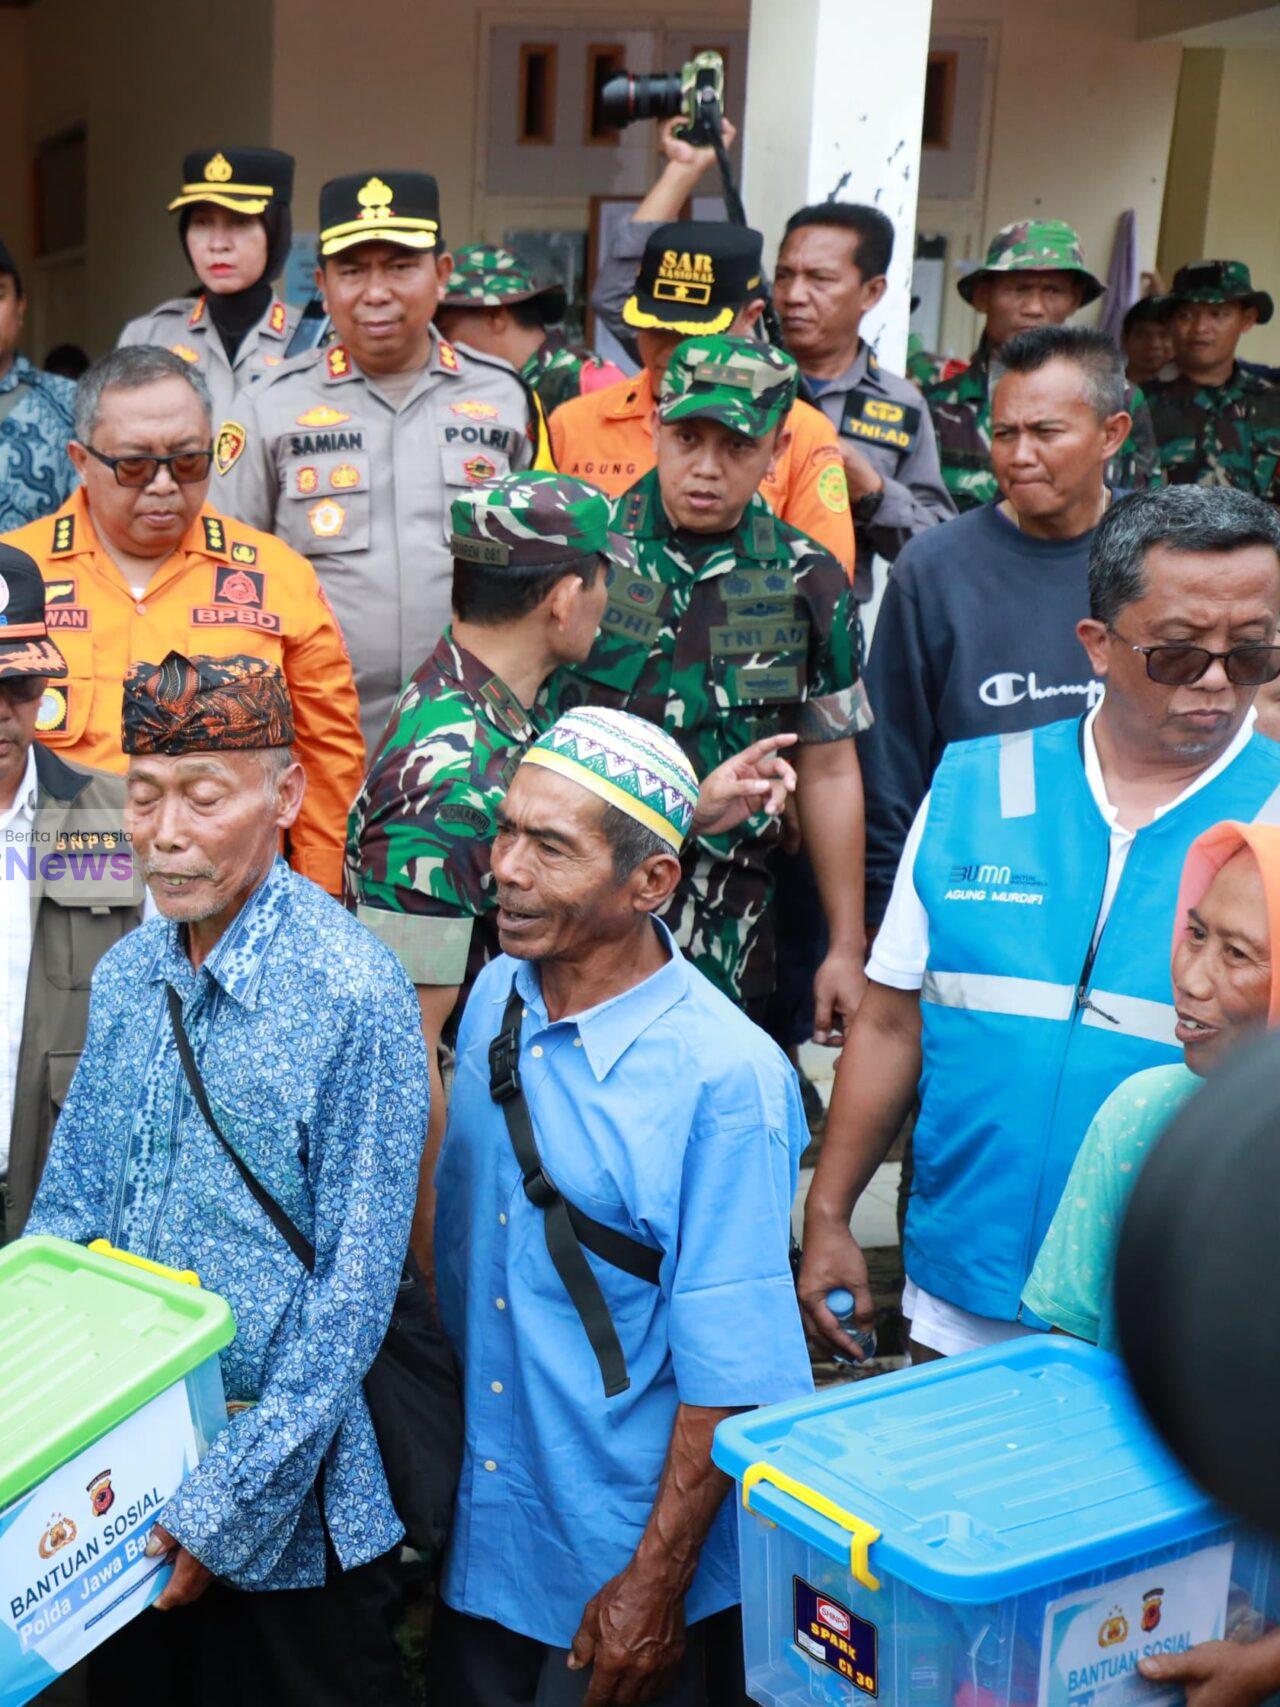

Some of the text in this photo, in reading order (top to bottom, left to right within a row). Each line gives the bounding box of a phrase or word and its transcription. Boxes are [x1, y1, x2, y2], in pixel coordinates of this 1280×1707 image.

[662, 250, 713, 273] SAR
[658, 266, 715, 283] NASIONAL
[291, 432, 362, 456] SAMIAN
[445, 427, 510, 449] POLRI
[849, 418, 910, 447] TNI-AD
[571, 462, 636, 475] AGUNG
[196, 608, 277, 629] BPBD
[720, 631, 762, 647] TNI
[979, 672, 1106, 709] Champ
[944, 889, 1043, 905] AGUNG MURDIFI
[10, 1537, 100, 1619] BANTUAN
[103, 1487, 165, 1546] SOSIAL
[20, 1597, 72, 1646] Polda
[80, 1554, 123, 1600] Jawa
[821, 1607, 849, 1630] SHINPO
[811, 1622, 856, 1661] SPARK
[1069, 1631, 1193, 1692] BANTUAN SOSIAL
[856, 1672, 874, 1690] 30
